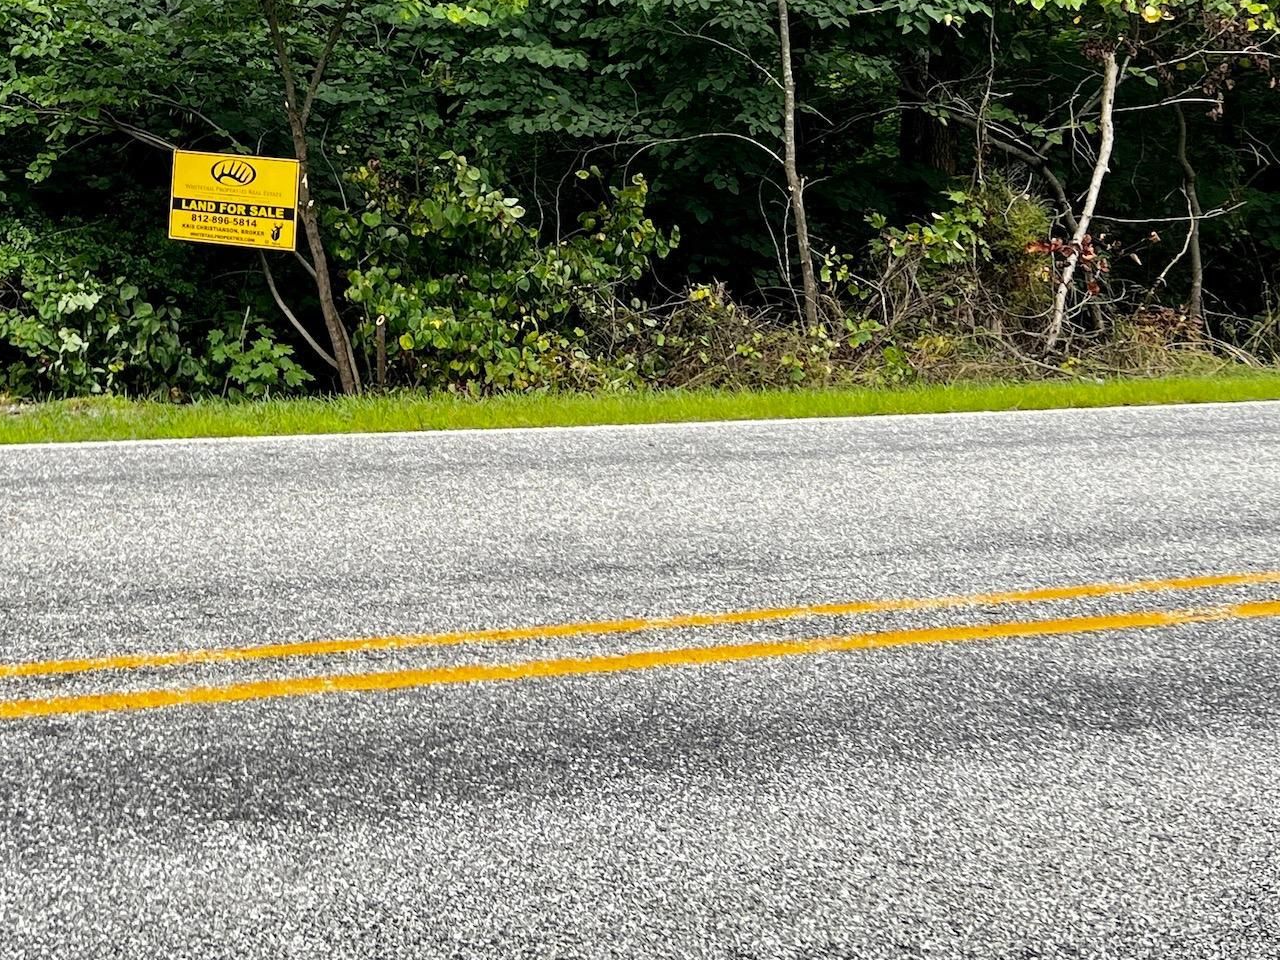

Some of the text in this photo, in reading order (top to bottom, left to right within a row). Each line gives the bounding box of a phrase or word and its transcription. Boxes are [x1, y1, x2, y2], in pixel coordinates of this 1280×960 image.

[181, 199, 285, 219] LAND FOR SALE
[191, 213, 257, 227] 812-896-5814
